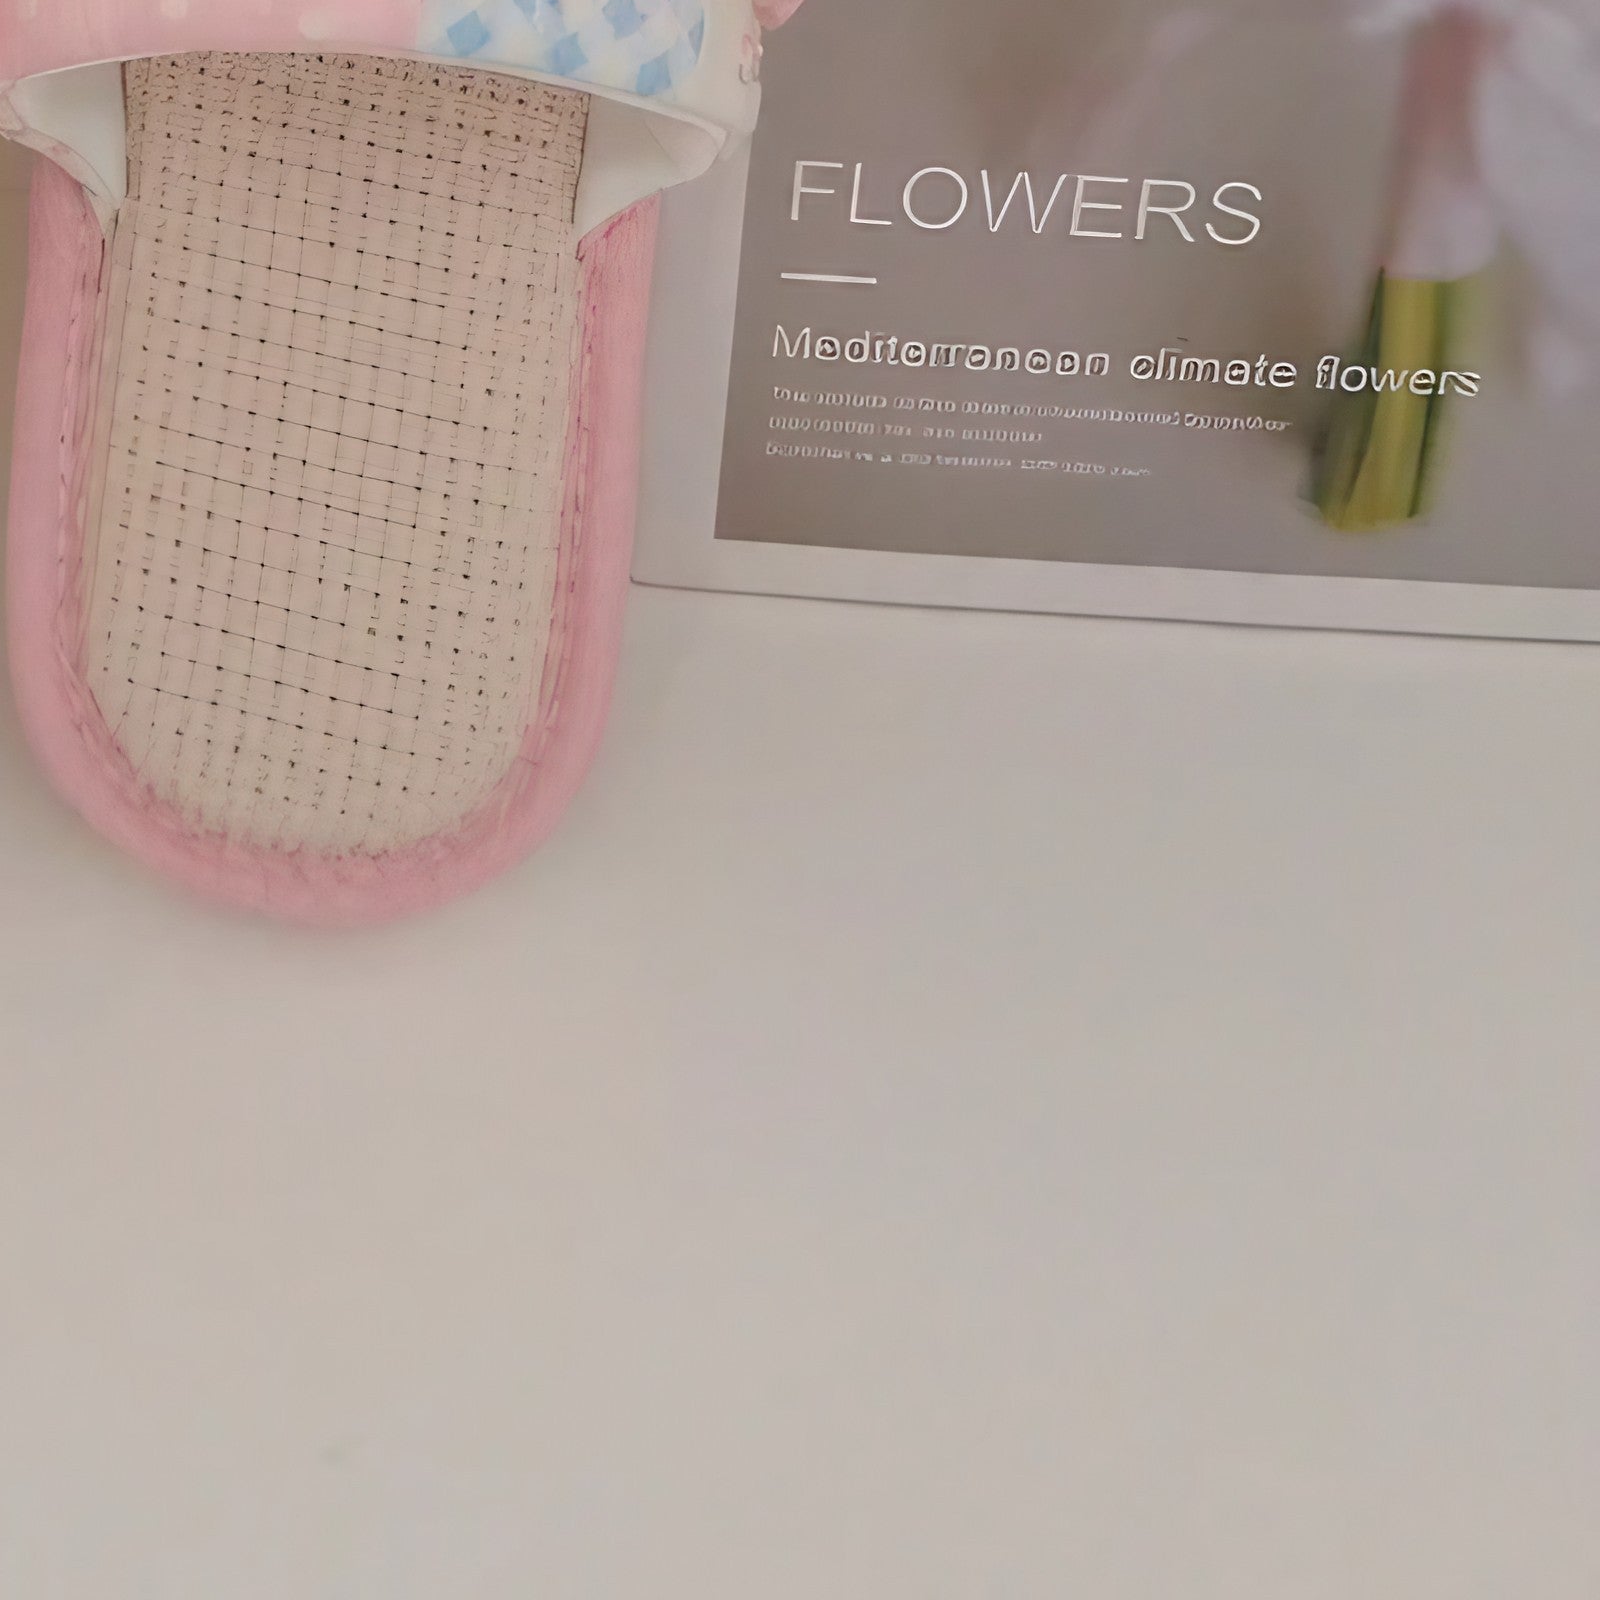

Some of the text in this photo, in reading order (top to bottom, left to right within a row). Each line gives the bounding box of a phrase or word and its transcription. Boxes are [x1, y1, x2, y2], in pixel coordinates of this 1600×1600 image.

[790, 159, 1263, 246] FLOWERS
[1129, 347, 1298, 389] climate
[1314, 355, 1482, 398] flowers
